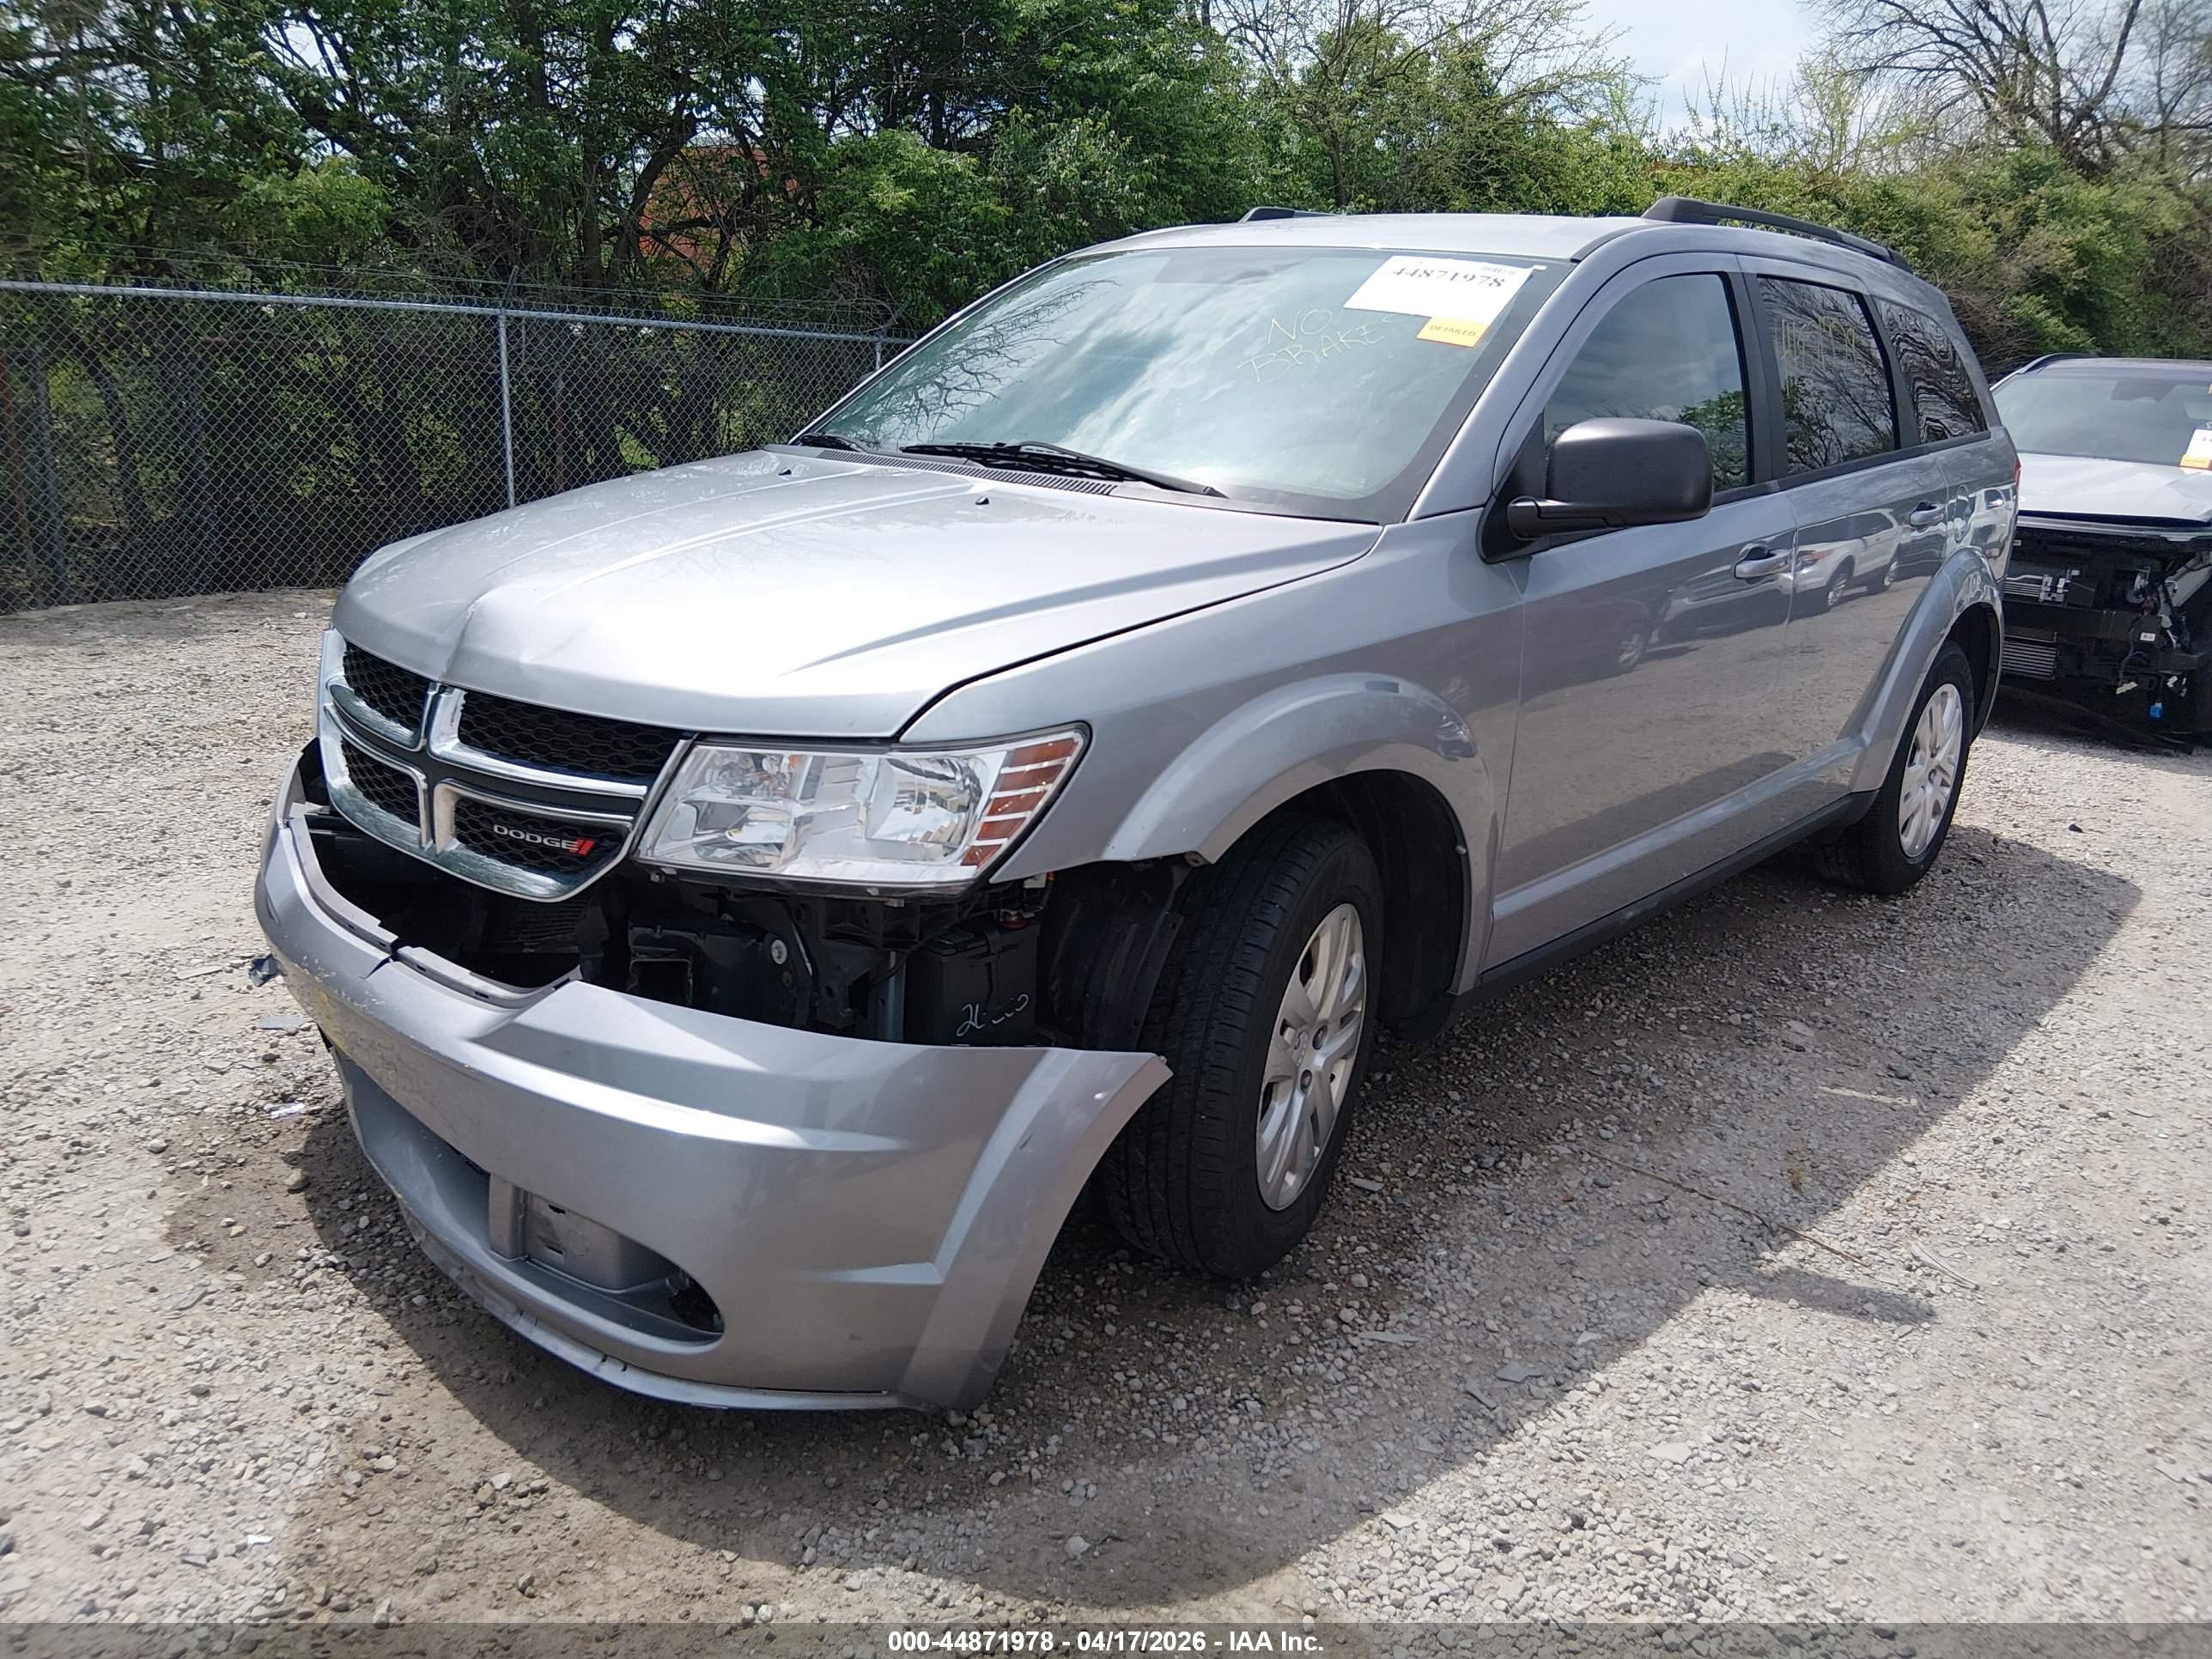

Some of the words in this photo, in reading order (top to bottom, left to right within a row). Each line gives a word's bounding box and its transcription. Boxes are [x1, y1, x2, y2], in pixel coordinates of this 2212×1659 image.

[1391, 267, 1505, 288] 44871978
[1267, 309, 1334, 344] NO
[1430, 325, 1477, 337] DETAILED
[493, 824, 580, 852] DODGE
